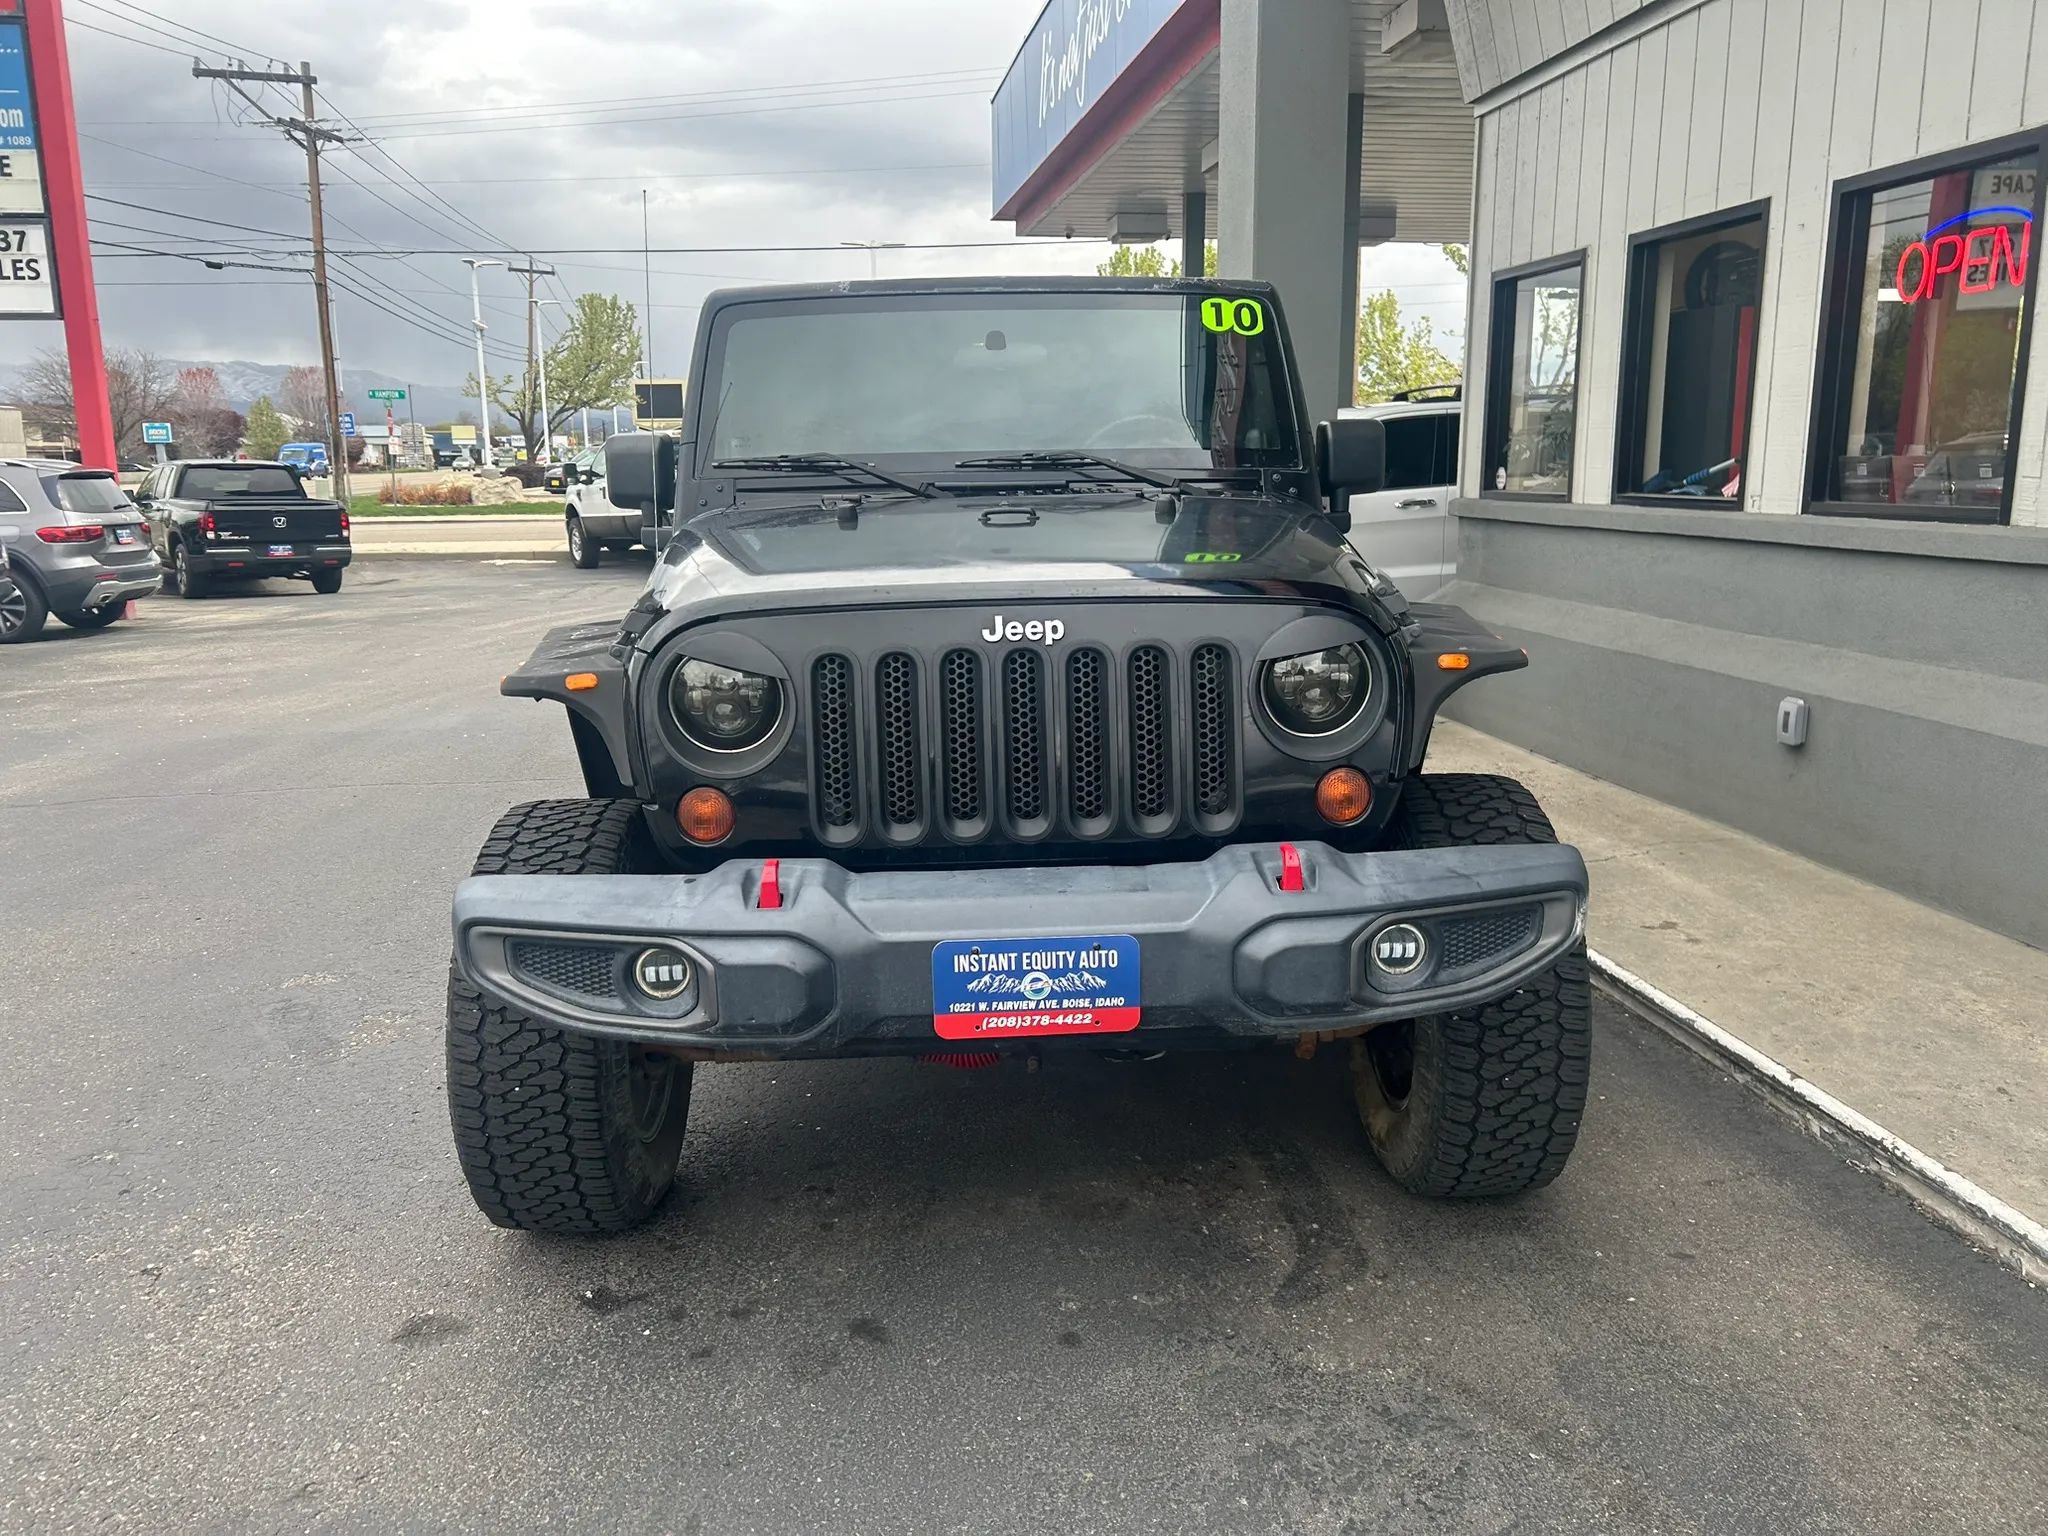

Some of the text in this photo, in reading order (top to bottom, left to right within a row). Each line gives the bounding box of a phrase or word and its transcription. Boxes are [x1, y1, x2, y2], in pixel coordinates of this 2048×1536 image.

[7, 136, 32, 146] 1089
[0, 155, 12, 177] E
[0, 230, 26, 252] 37
[1897, 221, 2032, 303] OPEN
[1209, 302, 1259, 332] 10
[981, 615, 1064, 646] Jeep
[953, 949, 1118, 973] INSTANT EQUITY AUTO
[949, 996, 1125, 1013] 10221 W. FAIRVIEW AVE. BOISE, IDAHO
[982, 1013, 1092, 1030] (208)378-4422
